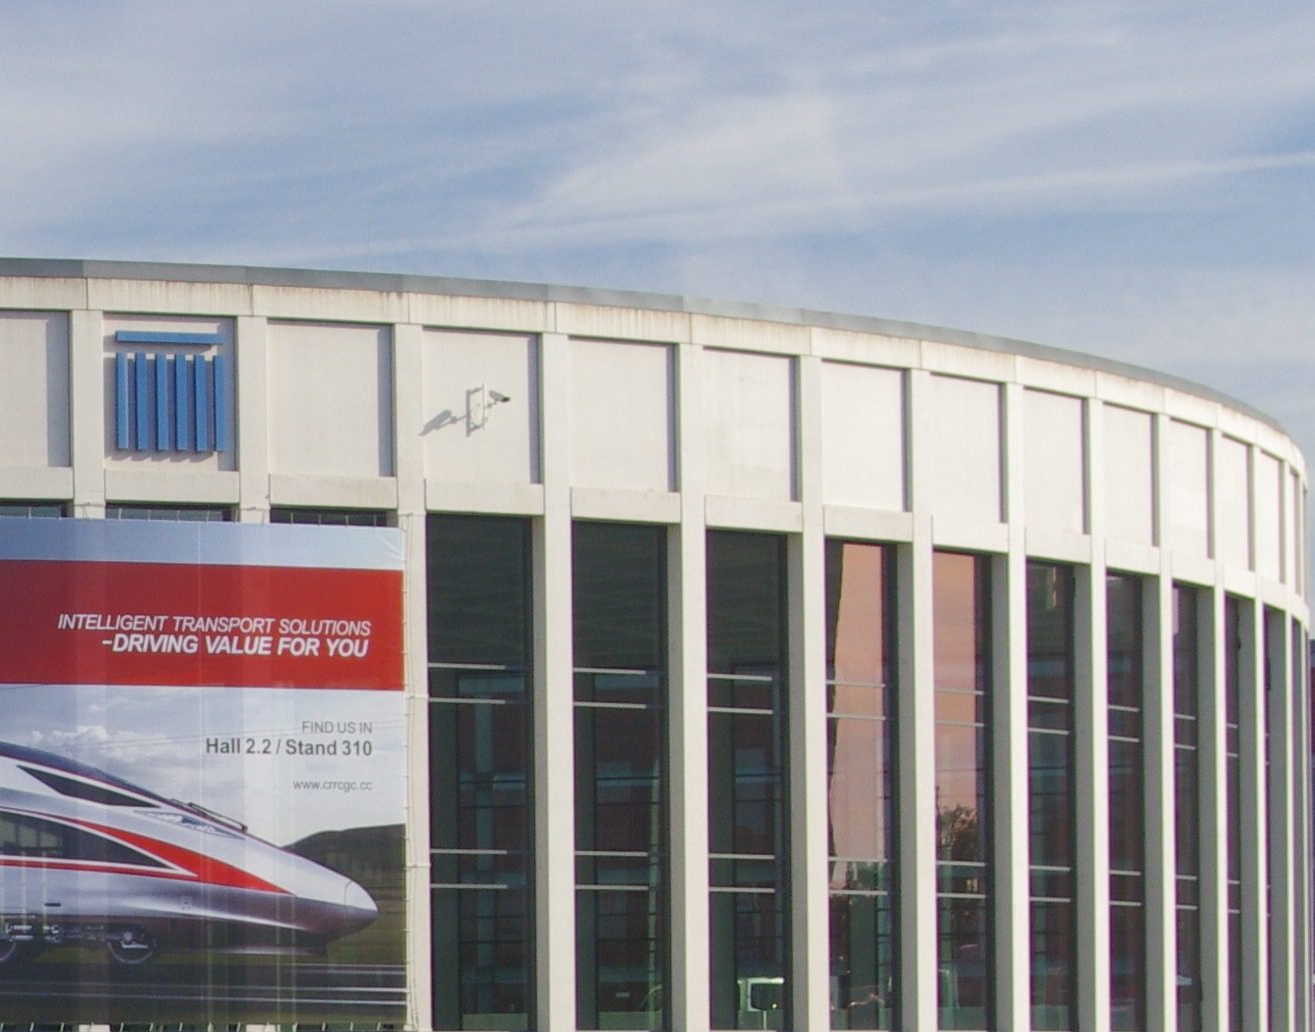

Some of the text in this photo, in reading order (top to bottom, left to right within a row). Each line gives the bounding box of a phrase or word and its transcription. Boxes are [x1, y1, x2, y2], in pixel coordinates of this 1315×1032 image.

[57, 613, 372, 636] INTELLIGENT TRANSPORT SOLUTIONS
[102, 633, 369, 658] -DRIVING VALUE FOR YOU
[302, 721, 373, 734] FIND US IN
[206, 738, 373, 756] Hall 2.2 / Stand 310
[293, 780, 373, 793] www.crrcgc.cc
